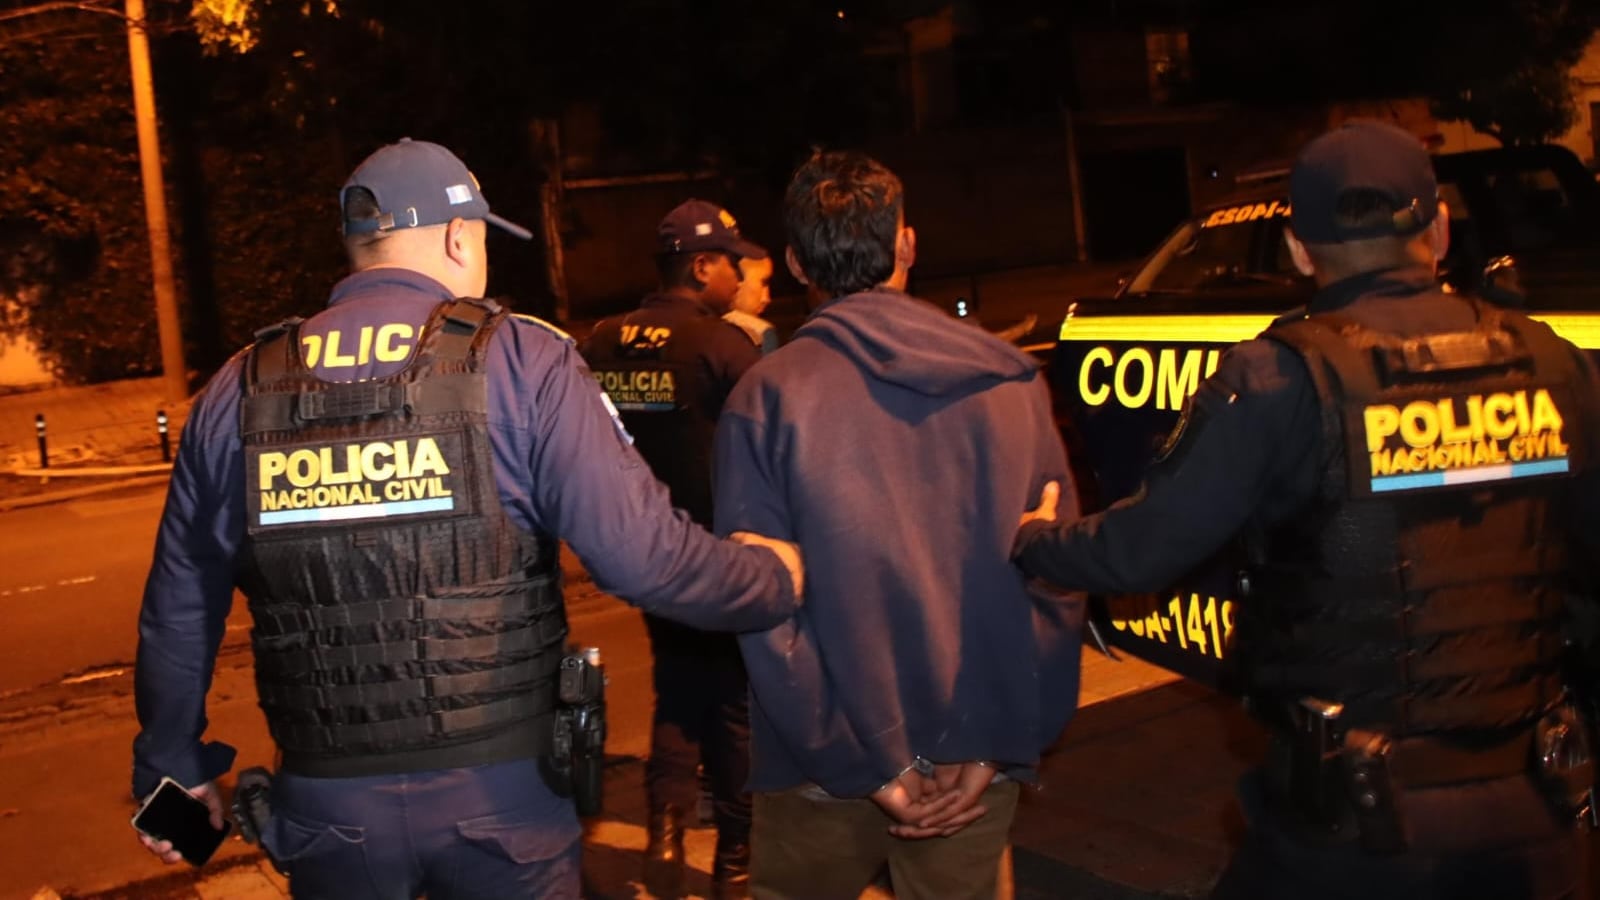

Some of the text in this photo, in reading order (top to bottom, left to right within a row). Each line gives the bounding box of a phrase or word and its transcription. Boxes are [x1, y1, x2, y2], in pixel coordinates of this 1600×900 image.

[302, 322, 425, 369] OLIC
[593, 371, 674, 392] POLICIA
[643, 391, 675, 403] CIVIL
[1364, 388, 1563, 452] POLICIA
[258, 438, 450, 489] POLICIA
[1371, 431, 1568, 476] NACIONAL CIVIL
[261, 477, 452, 511] NACIONAL CIVIL
